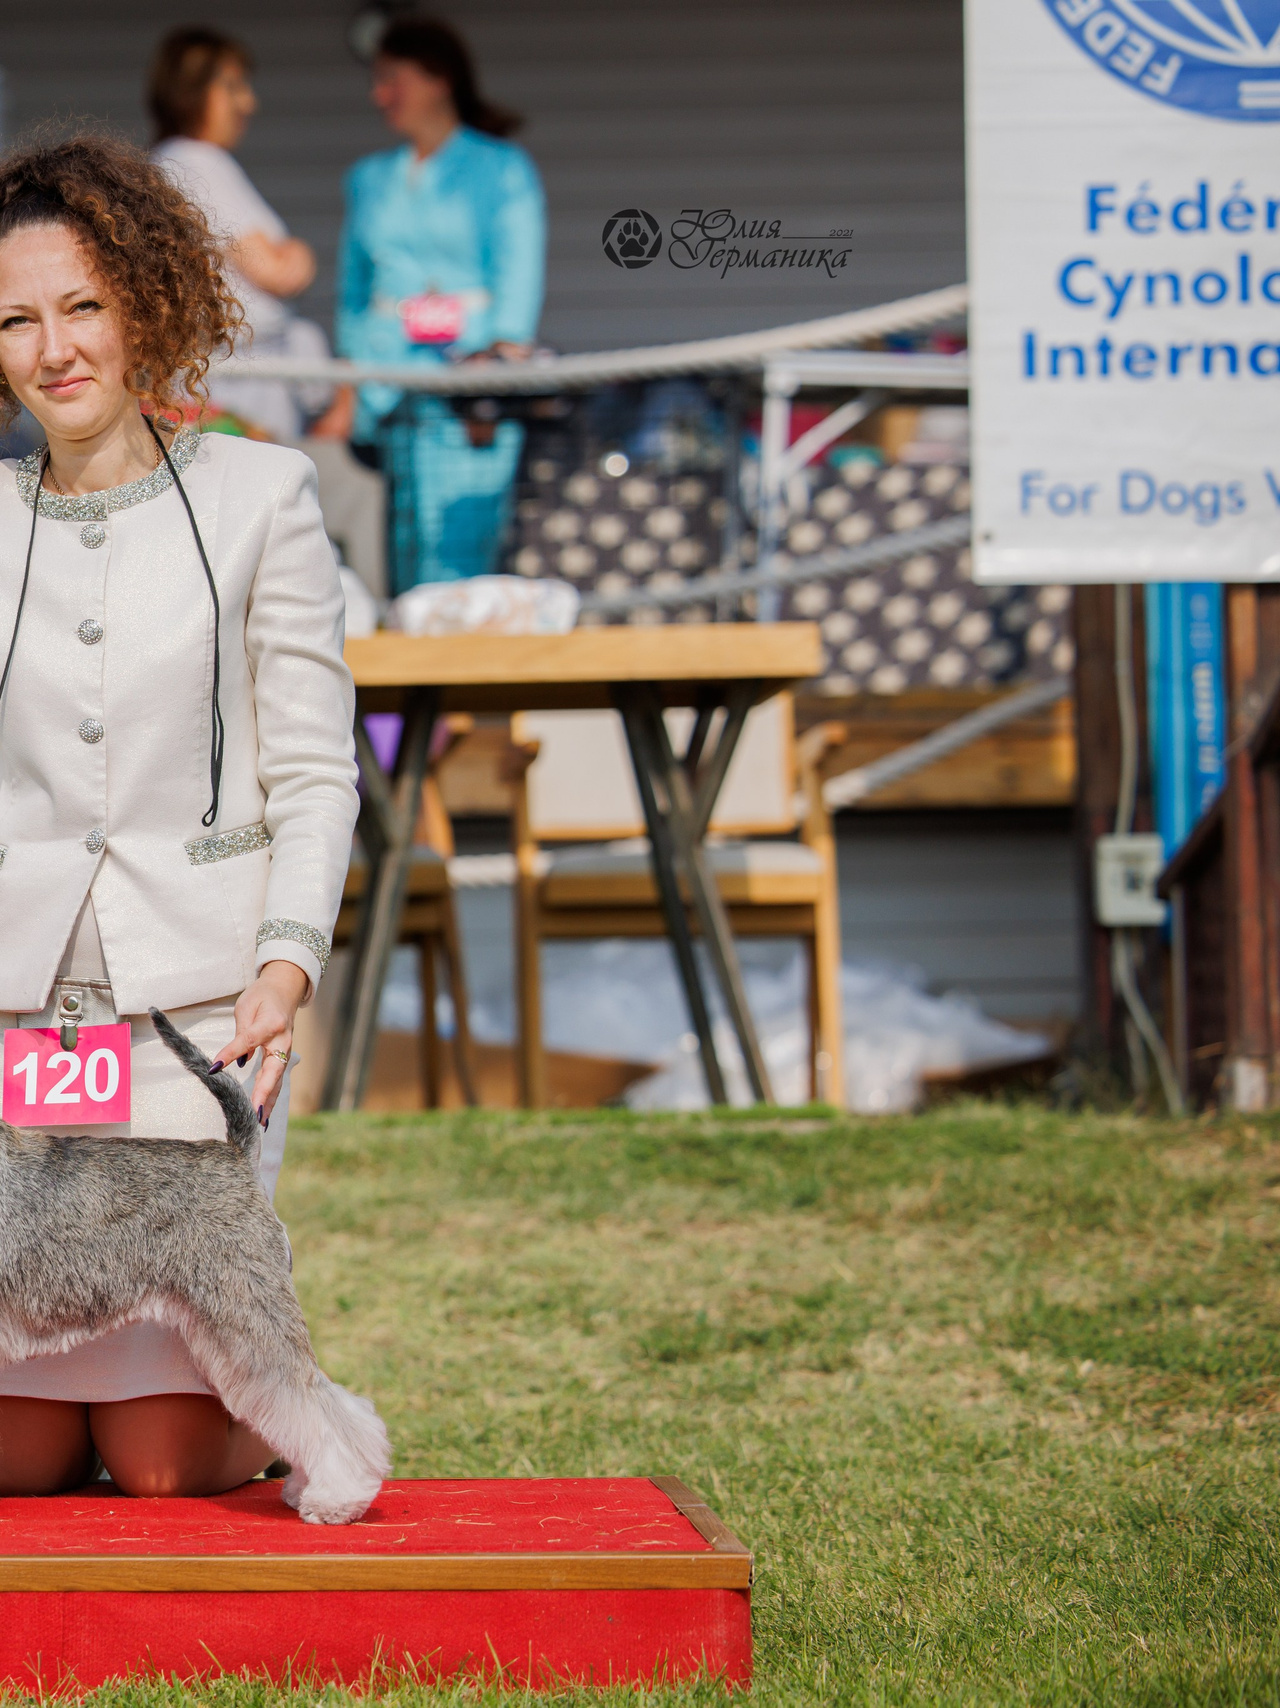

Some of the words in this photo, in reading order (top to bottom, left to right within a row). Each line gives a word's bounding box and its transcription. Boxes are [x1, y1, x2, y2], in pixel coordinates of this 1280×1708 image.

[1085, 180, 1280, 234] Fédér
[1022, 331, 1280, 379] Interna
[1020, 470, 1100, 517] For
[1119, 469, 1247, 527] Dogs
[12, 1048, 120, 1106] 120
